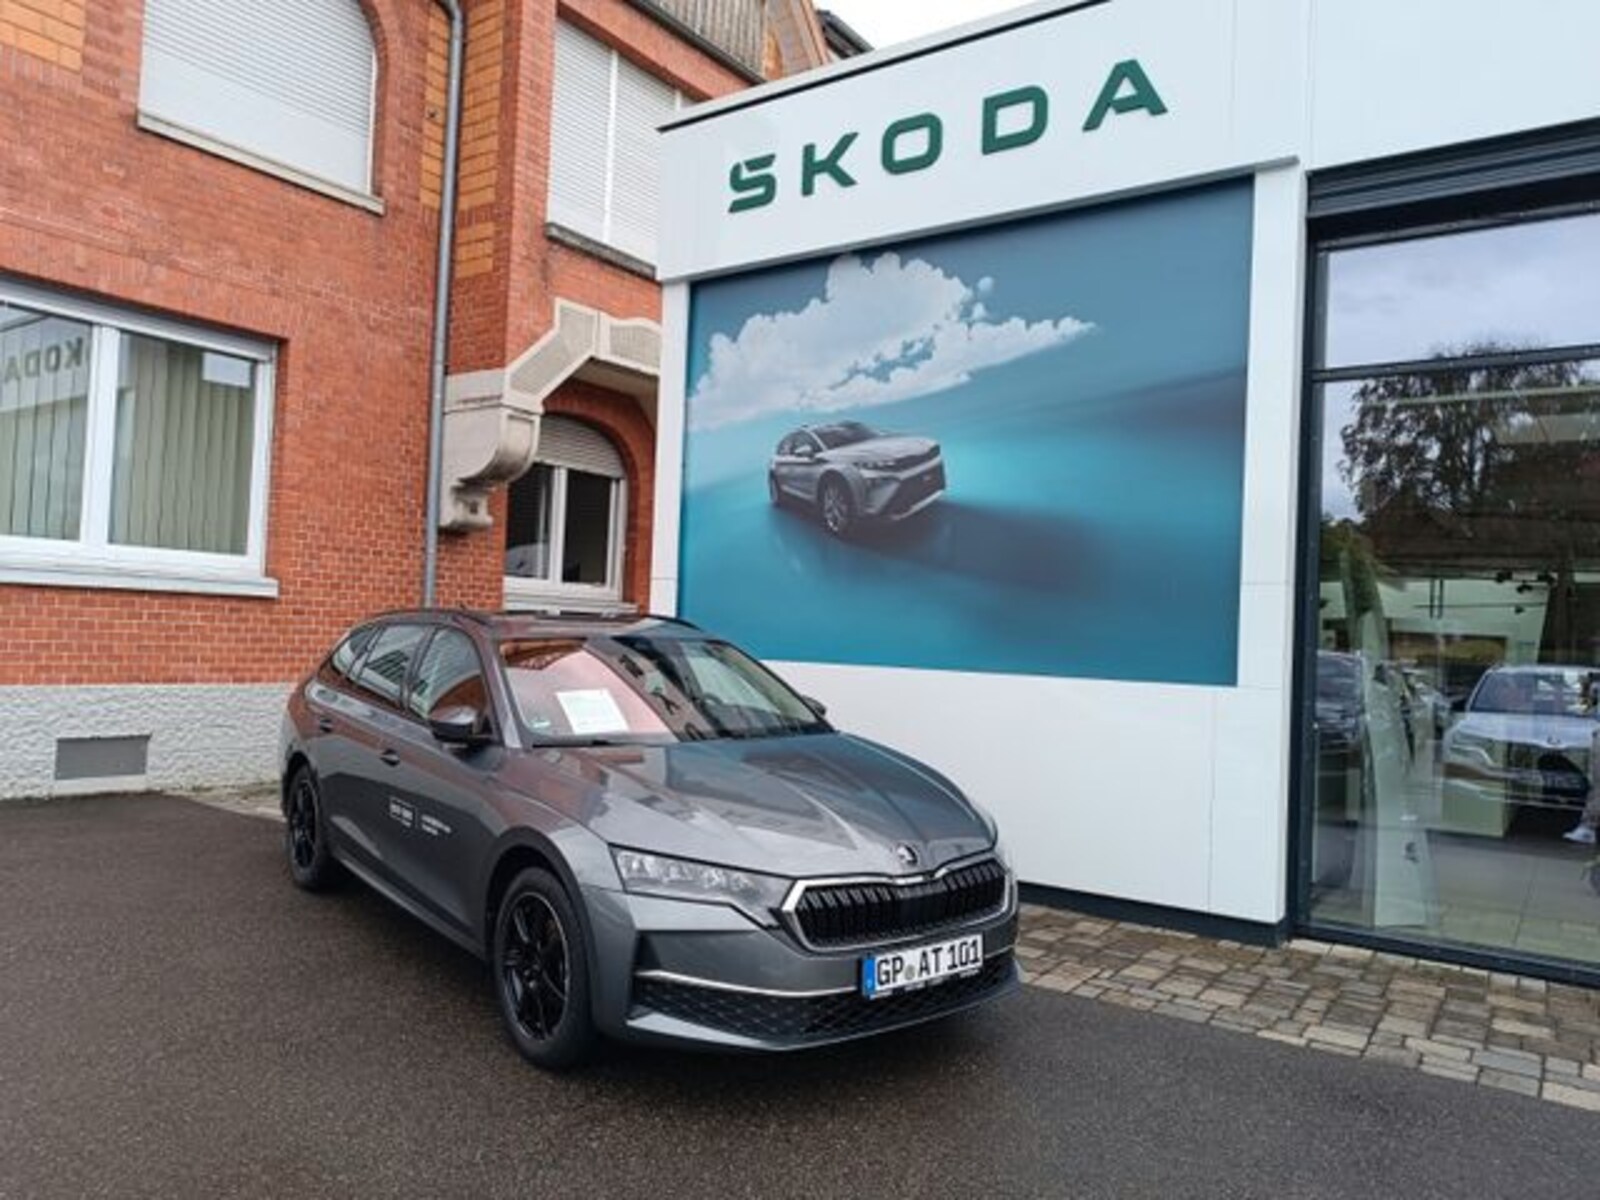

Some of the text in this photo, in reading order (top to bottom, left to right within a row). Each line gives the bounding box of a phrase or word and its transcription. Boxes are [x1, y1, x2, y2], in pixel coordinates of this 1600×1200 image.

[877, 956, 904, 985] GP
[918, 947, 943, 978] AT
[947, 939, 981, 970] 101
